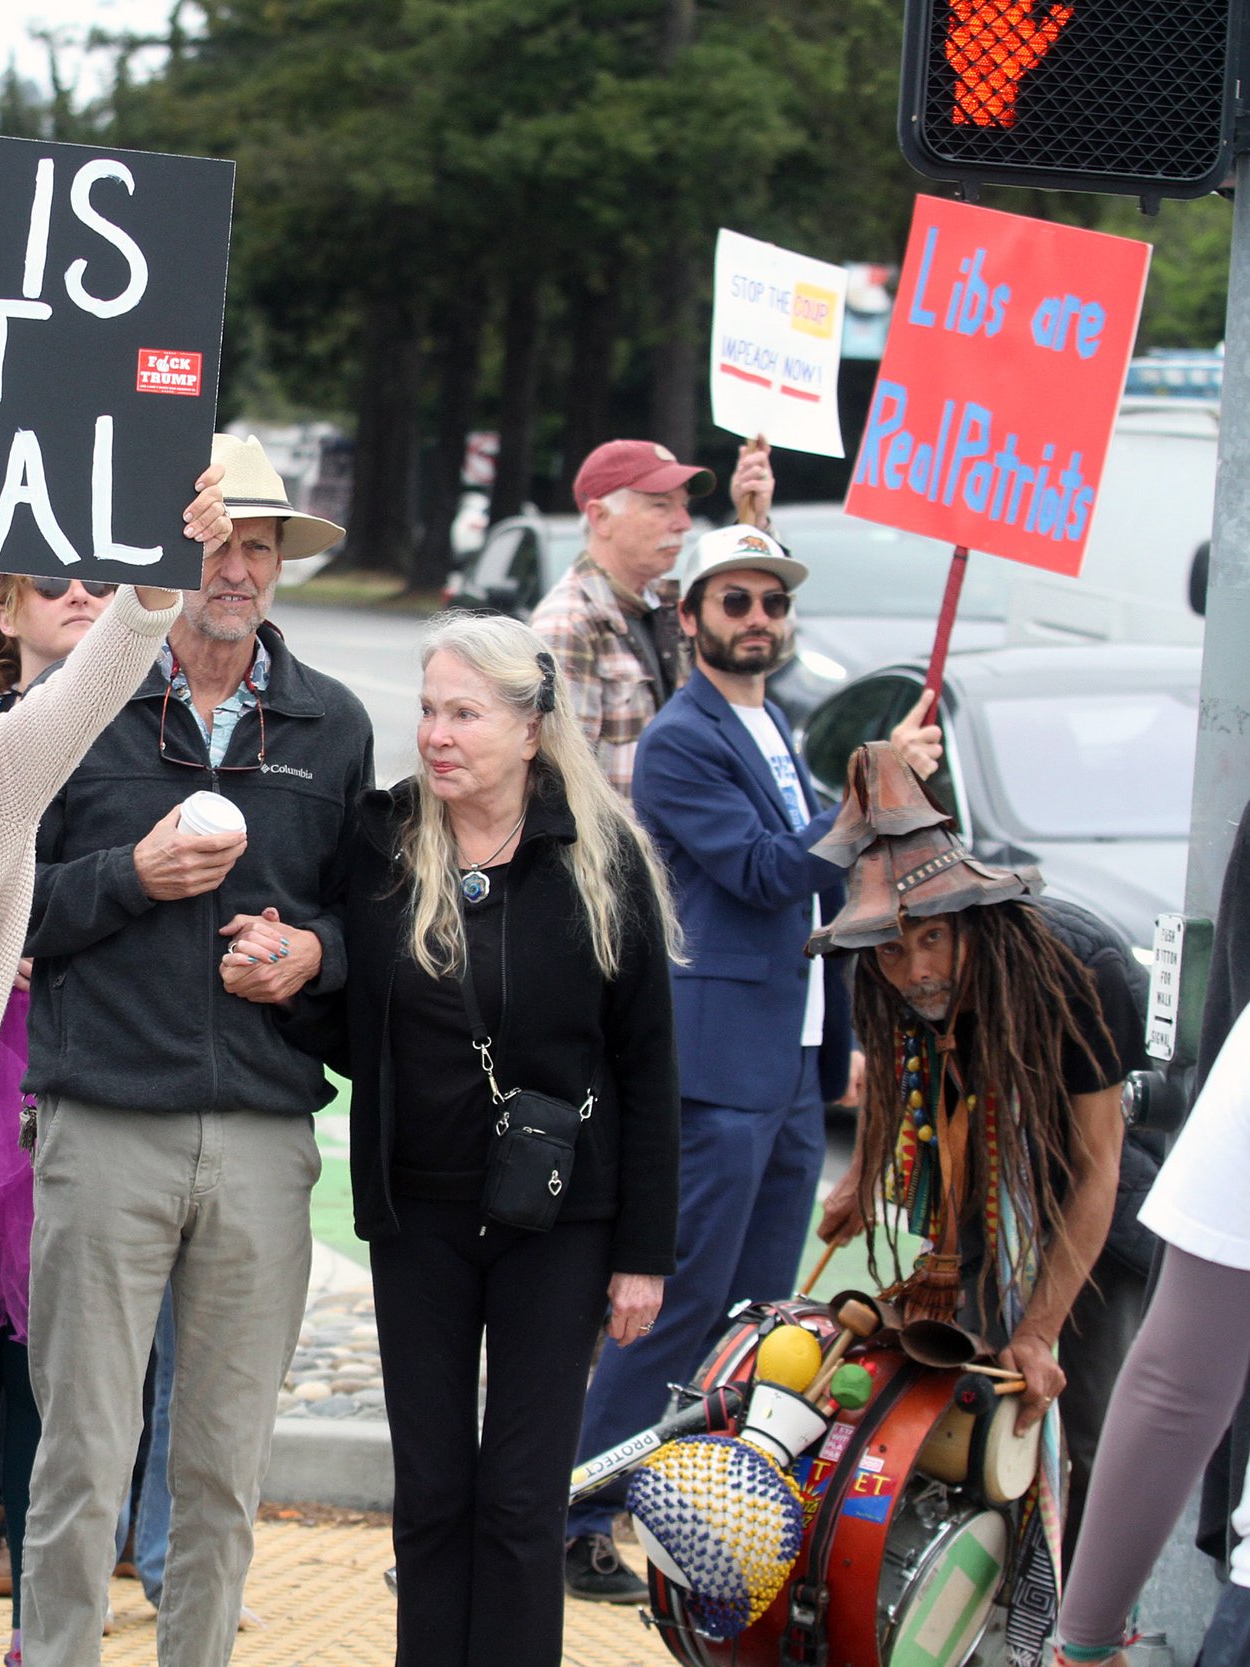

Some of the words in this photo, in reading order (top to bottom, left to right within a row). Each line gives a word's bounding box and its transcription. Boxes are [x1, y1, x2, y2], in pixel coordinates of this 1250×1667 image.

[22, 157, 148, 319] IS
[731, 275, 764, 303] STOP
[769, 285, 792, 315] THE
[793, 295, 828, 325] COUP
[908, 227, 1011, 337] Libs
[1030, 294, 1107, 359] are
[721, 336, 778, 372] IMPEACH
[140, 371, 197, 387] TRUMP
[270, 764, 313, 780] Columbia
[1156, 948, 1178, 965] BTTON
[1161, 970, 1171, 986] FOR
[1157, 991, 1171, 1008] WALK
[585, 1434, 654, 1478] PROTECT
